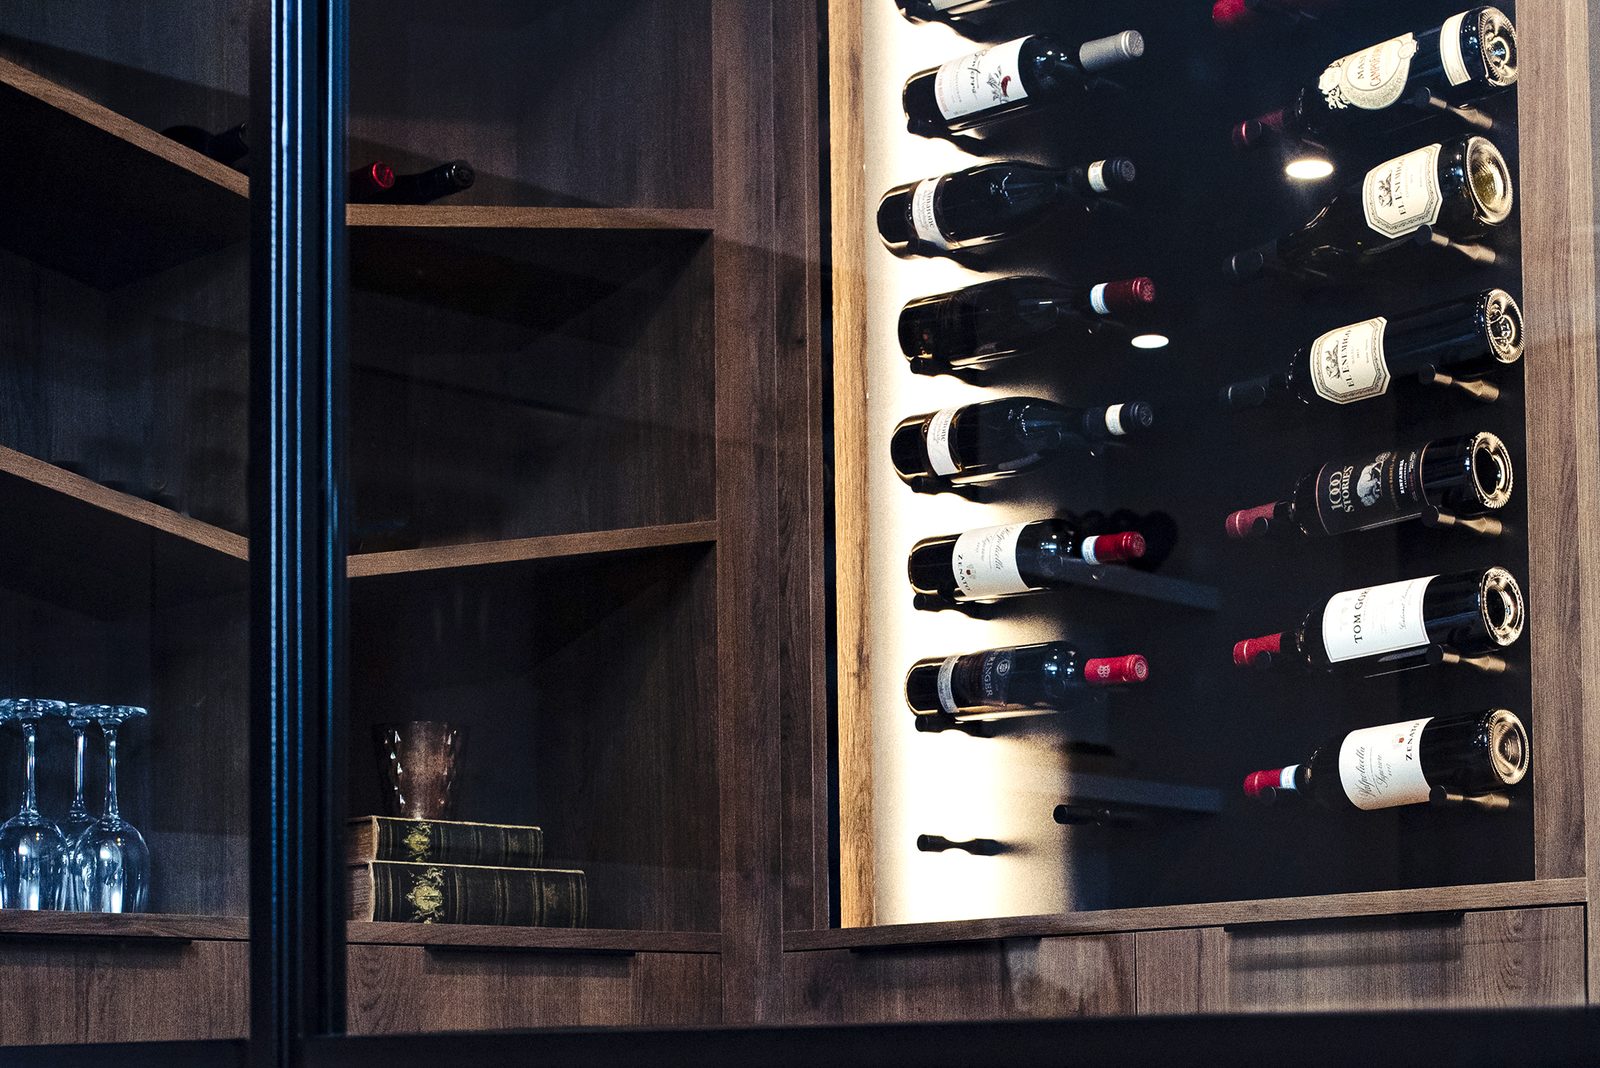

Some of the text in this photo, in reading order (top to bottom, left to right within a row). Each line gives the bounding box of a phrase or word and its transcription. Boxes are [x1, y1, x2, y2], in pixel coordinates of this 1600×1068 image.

[1357, 56, 1366, 79] MASI
[1398, 202, 1406, 215] EL
[1346, 374, 1355, 387] EL
[1329, 471, 1343, 510] 1000
[1342, 465, 1354, 512] STORIES
[958, 555, 972, 592] ZENATO
[1354, 614, 1363, 643] TOM
[1405, 722, 1420, 761] ZENATO
[1355, 746, 1376, 797] Valpolicella
